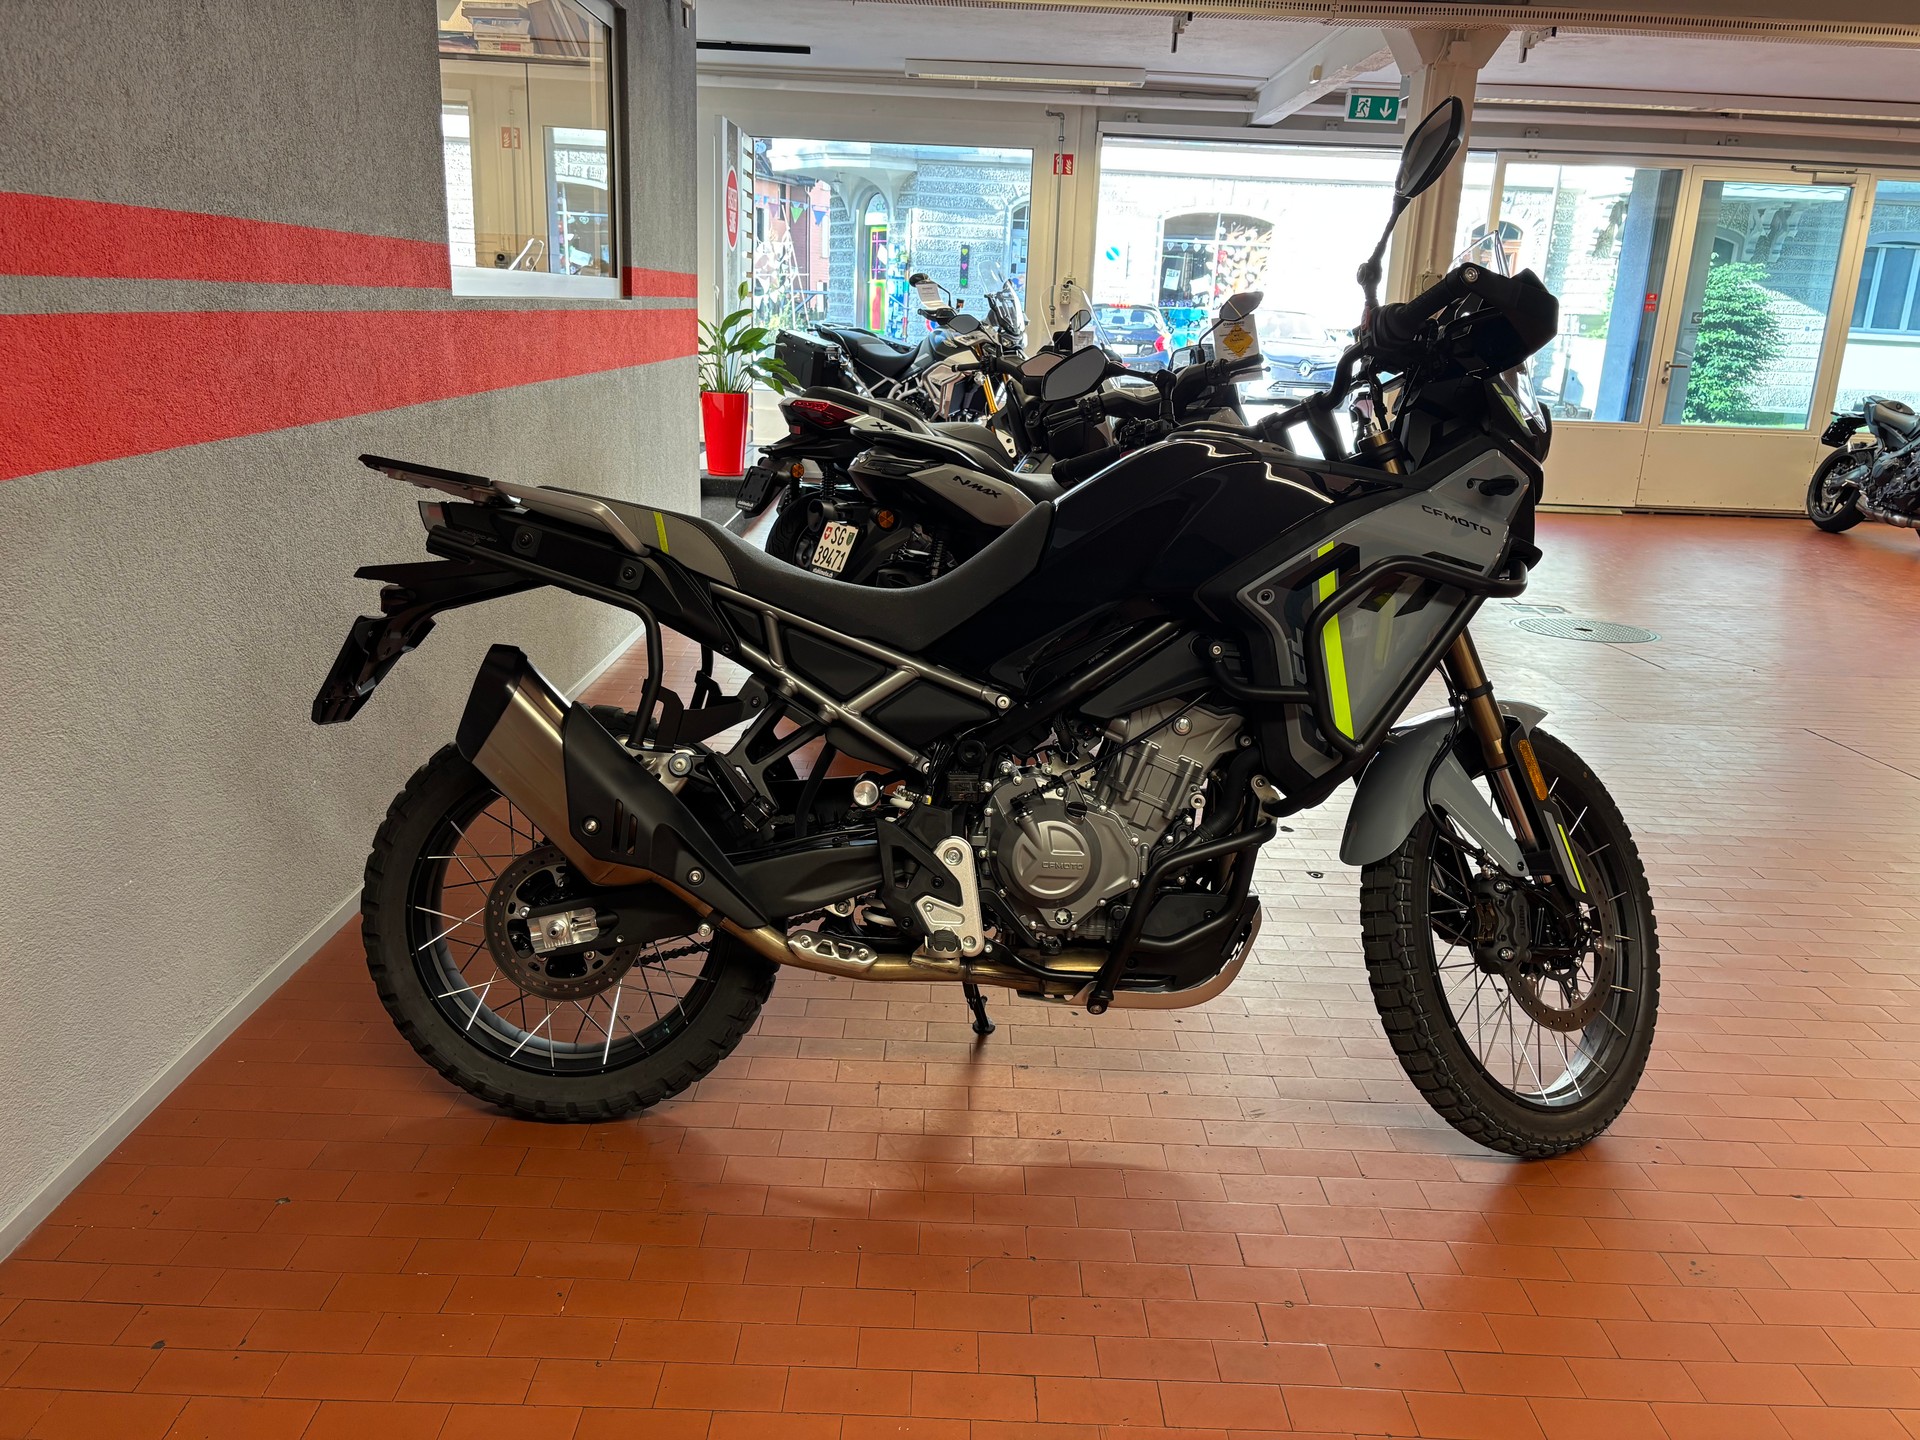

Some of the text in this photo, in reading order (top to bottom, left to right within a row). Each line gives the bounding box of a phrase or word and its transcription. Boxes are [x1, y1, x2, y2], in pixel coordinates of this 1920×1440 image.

[952, 475, 1002, 499] NMAX
[1421, 504, 1492, 536] CFMOTO
[830, 526, 847, 546] SG
[813, 545, 846, 571] 39471
[1041, 861, 1085, 870] CFMOTO
